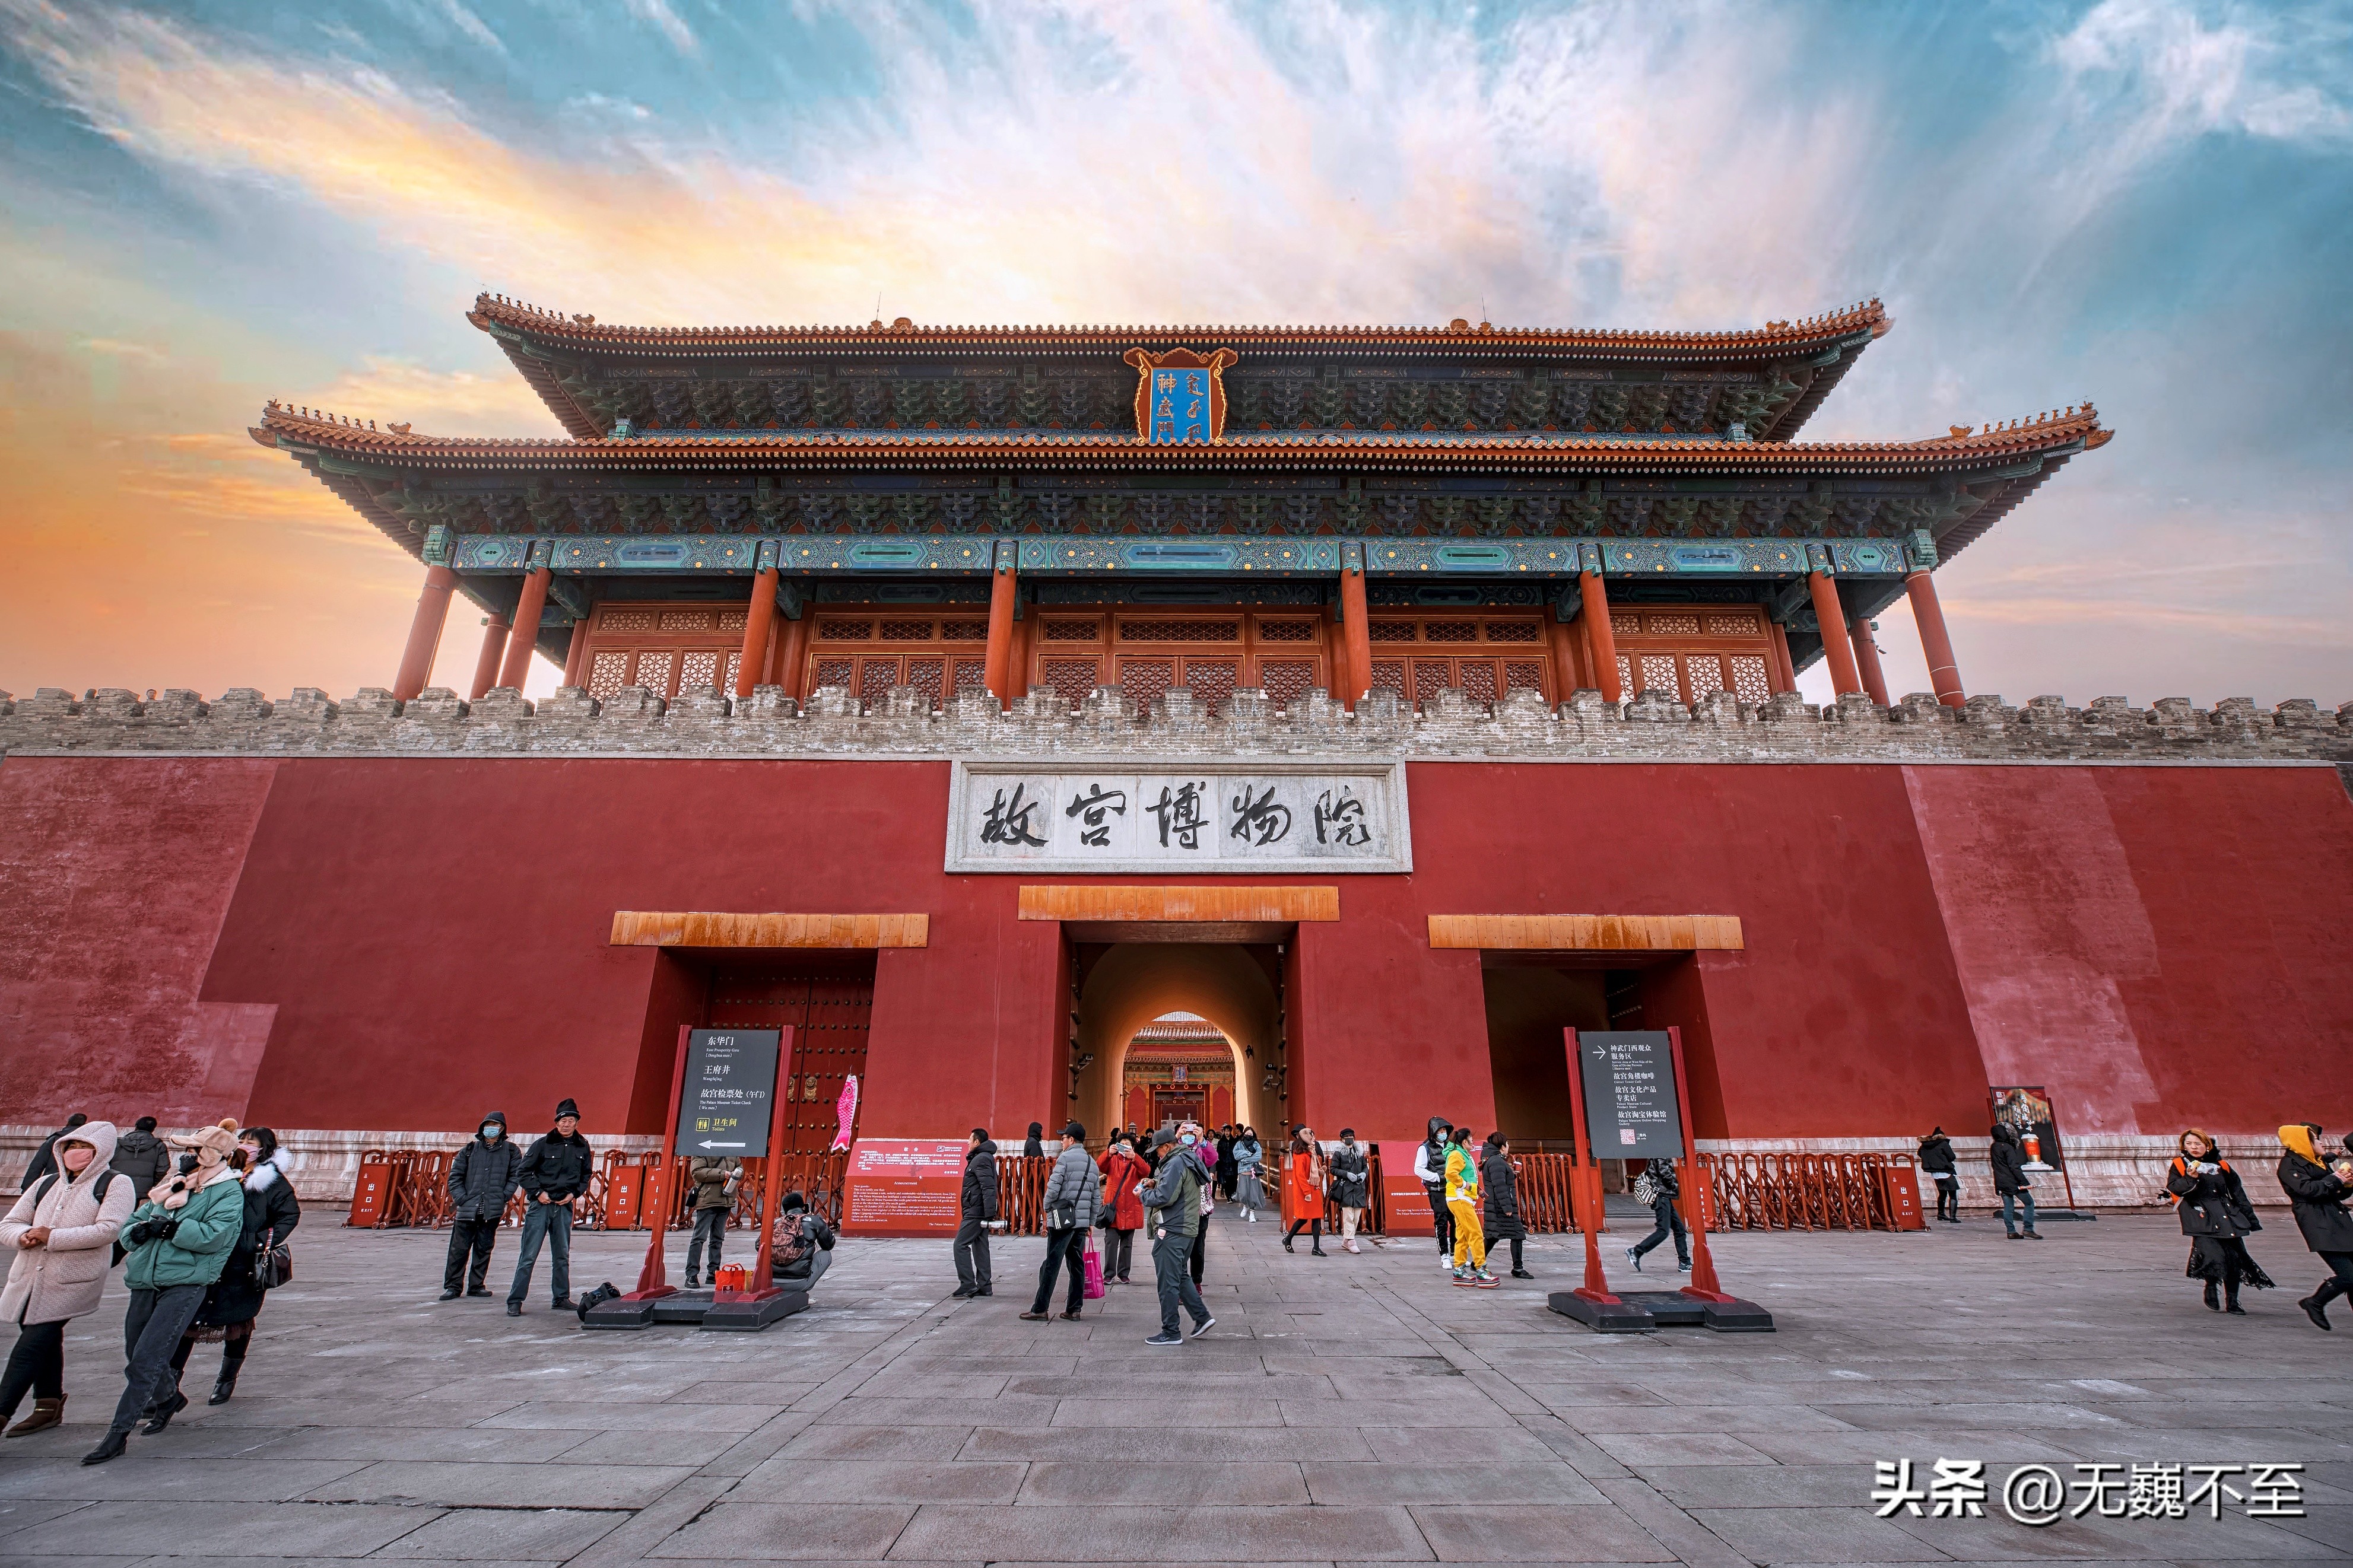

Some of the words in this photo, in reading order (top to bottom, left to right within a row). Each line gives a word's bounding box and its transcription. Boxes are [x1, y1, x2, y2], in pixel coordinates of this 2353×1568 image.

[979, 781, 1372, 850] 故宫博物院
[707, 1036, 733, 1046] 东华门
[703, 1064, 731, 1074] 王府井
[1618, 1110, 1666, 1118] 故宫淘宝体验馆
[712, 1118, 737, 1127] 卫生间
[366, 1183, 374, 1203] 出口
[619, 1185, 628, 1205] 出口
[1900, 1187, 1909, 1206] 出口
